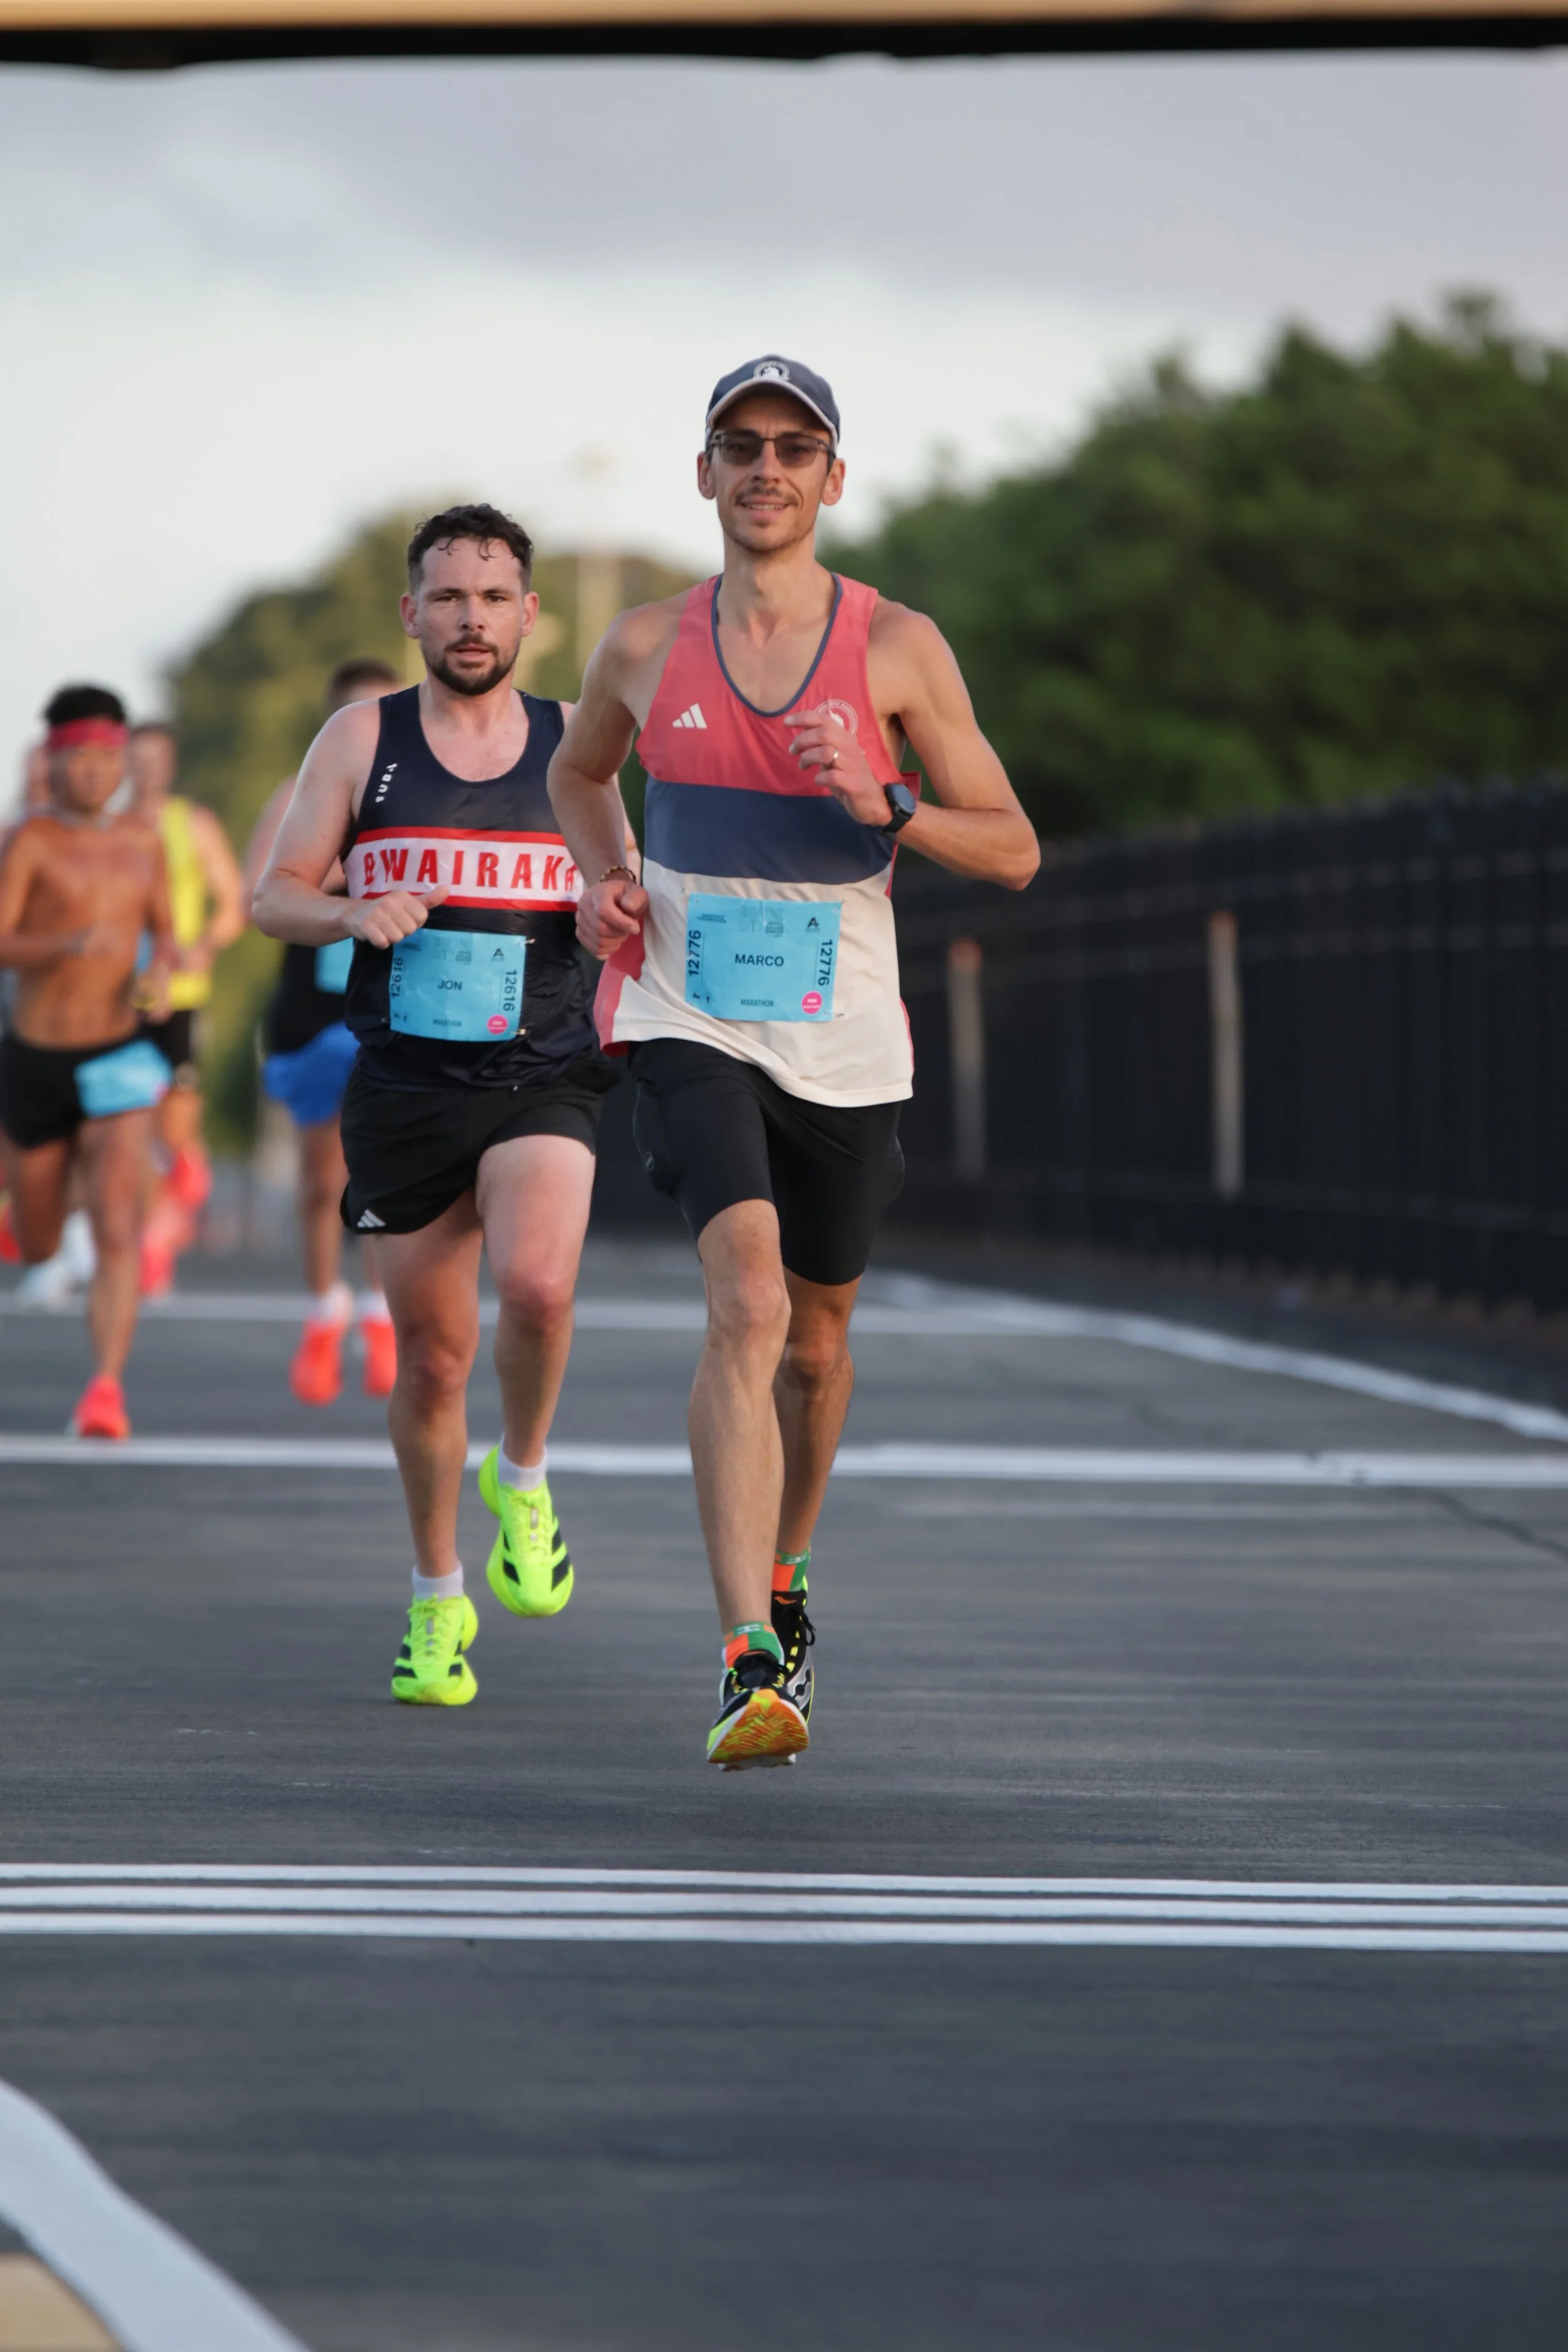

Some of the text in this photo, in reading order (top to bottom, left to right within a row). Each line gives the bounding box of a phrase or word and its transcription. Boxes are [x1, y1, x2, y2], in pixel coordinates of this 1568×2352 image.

[688, 930, 701, 977] 12776
[734, 953, 784, 967] MARCO
[818, 939, 833, 986] 12776
[391, 957, 403, 999] 12616
[437, 980, 462, 991] JON
[503, 969, 517, 1011] 12616
[741, 999, 774, 1007] MARATHON
